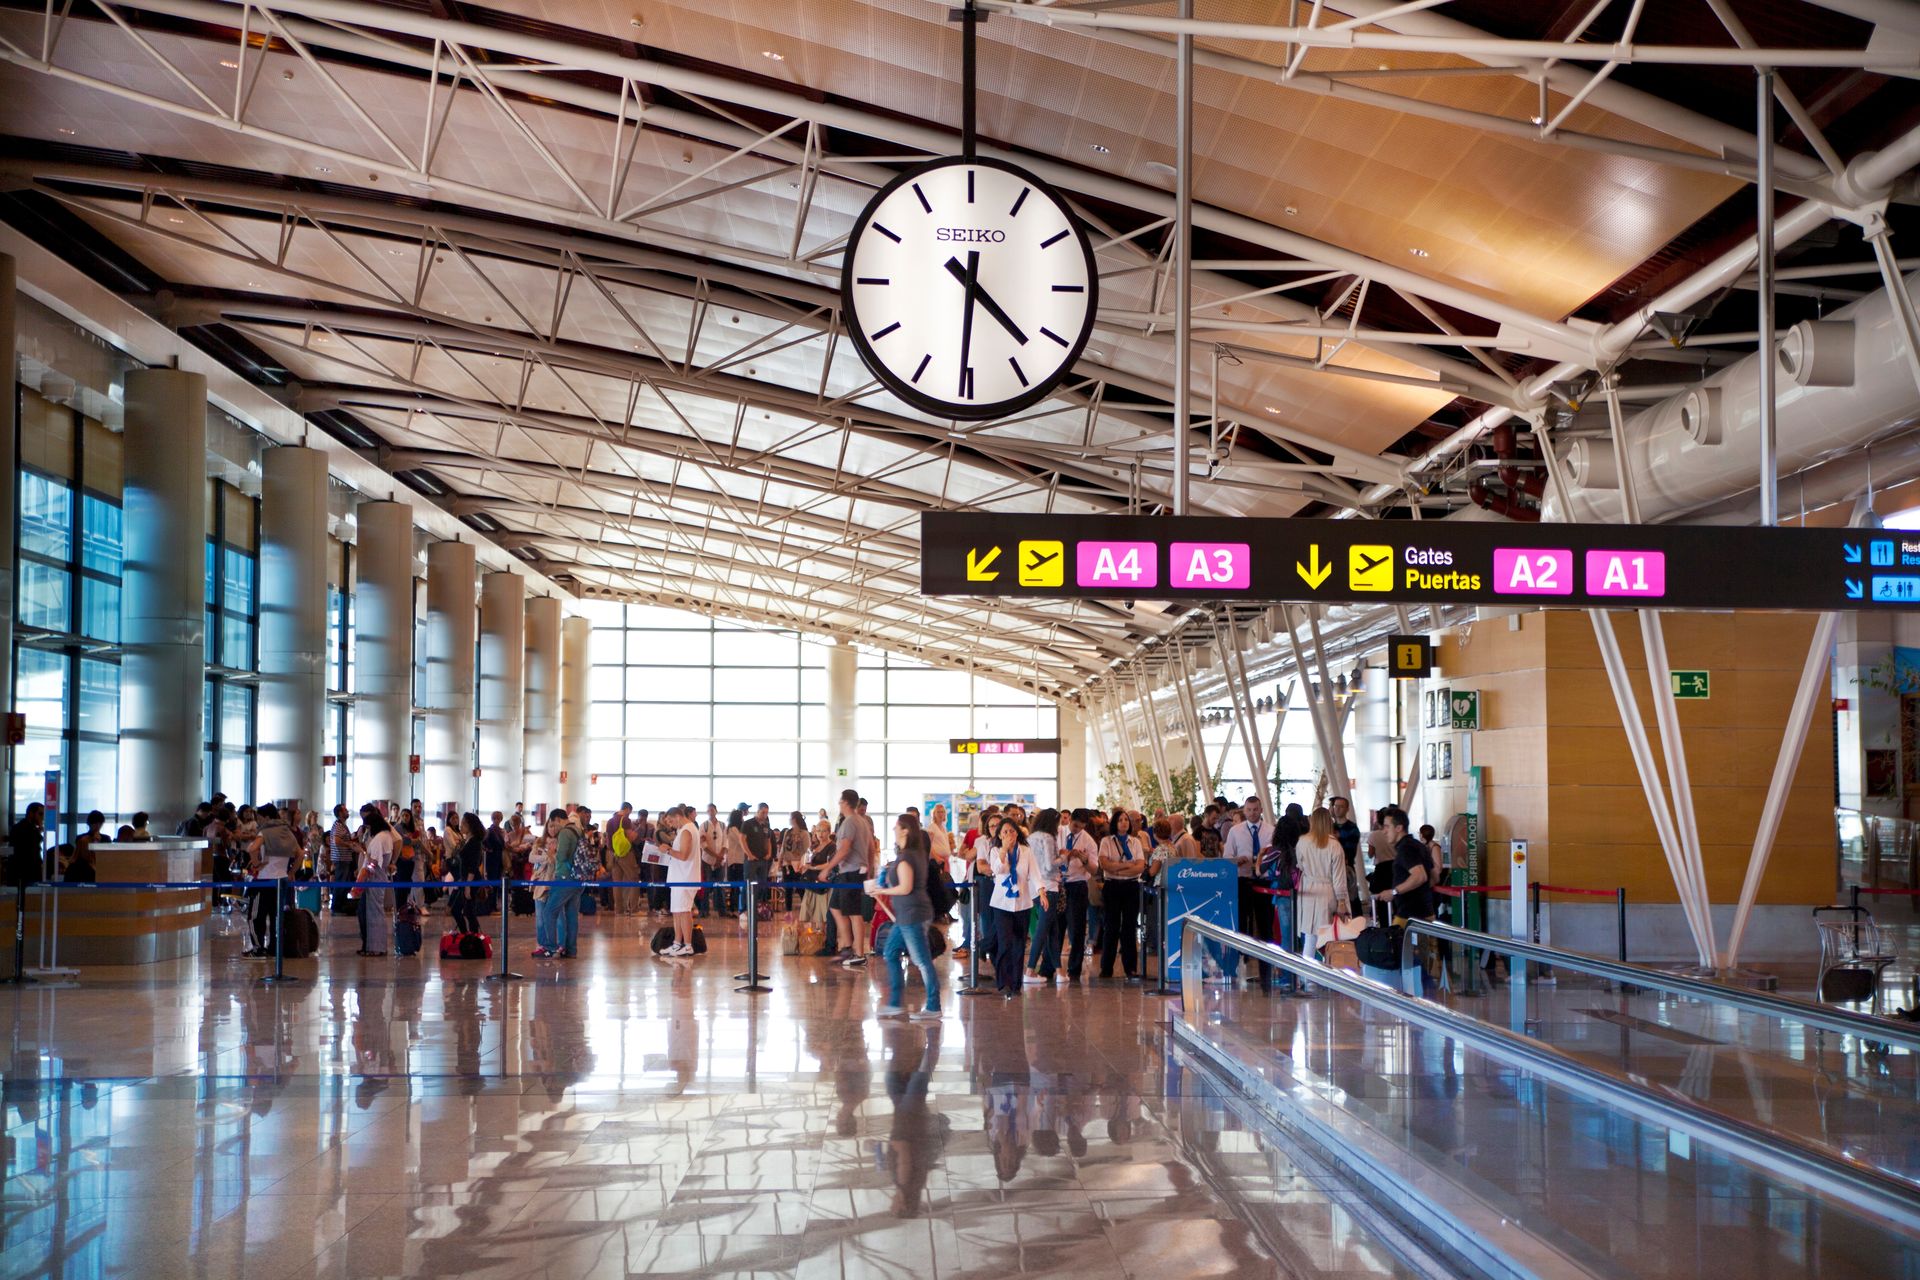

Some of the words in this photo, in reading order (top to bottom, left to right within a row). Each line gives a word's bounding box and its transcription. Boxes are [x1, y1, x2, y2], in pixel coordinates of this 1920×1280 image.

[936, 227, 1006, 243] SEIKO
[1092, 548, 1143, 581] A4
[1186, 549, 1234, 582] A3
[1404, 546, 1454, 566] Gates
[1405, 569, 1481, 591] Puertas
[1509, 555, 1558, 589] A2
[1603, 557, 1649, 590] A1
[1453, 720, 1476, 729] DEA
[984, 743, 997, 752] A2
[1007, 743, 1019, 752] A1
